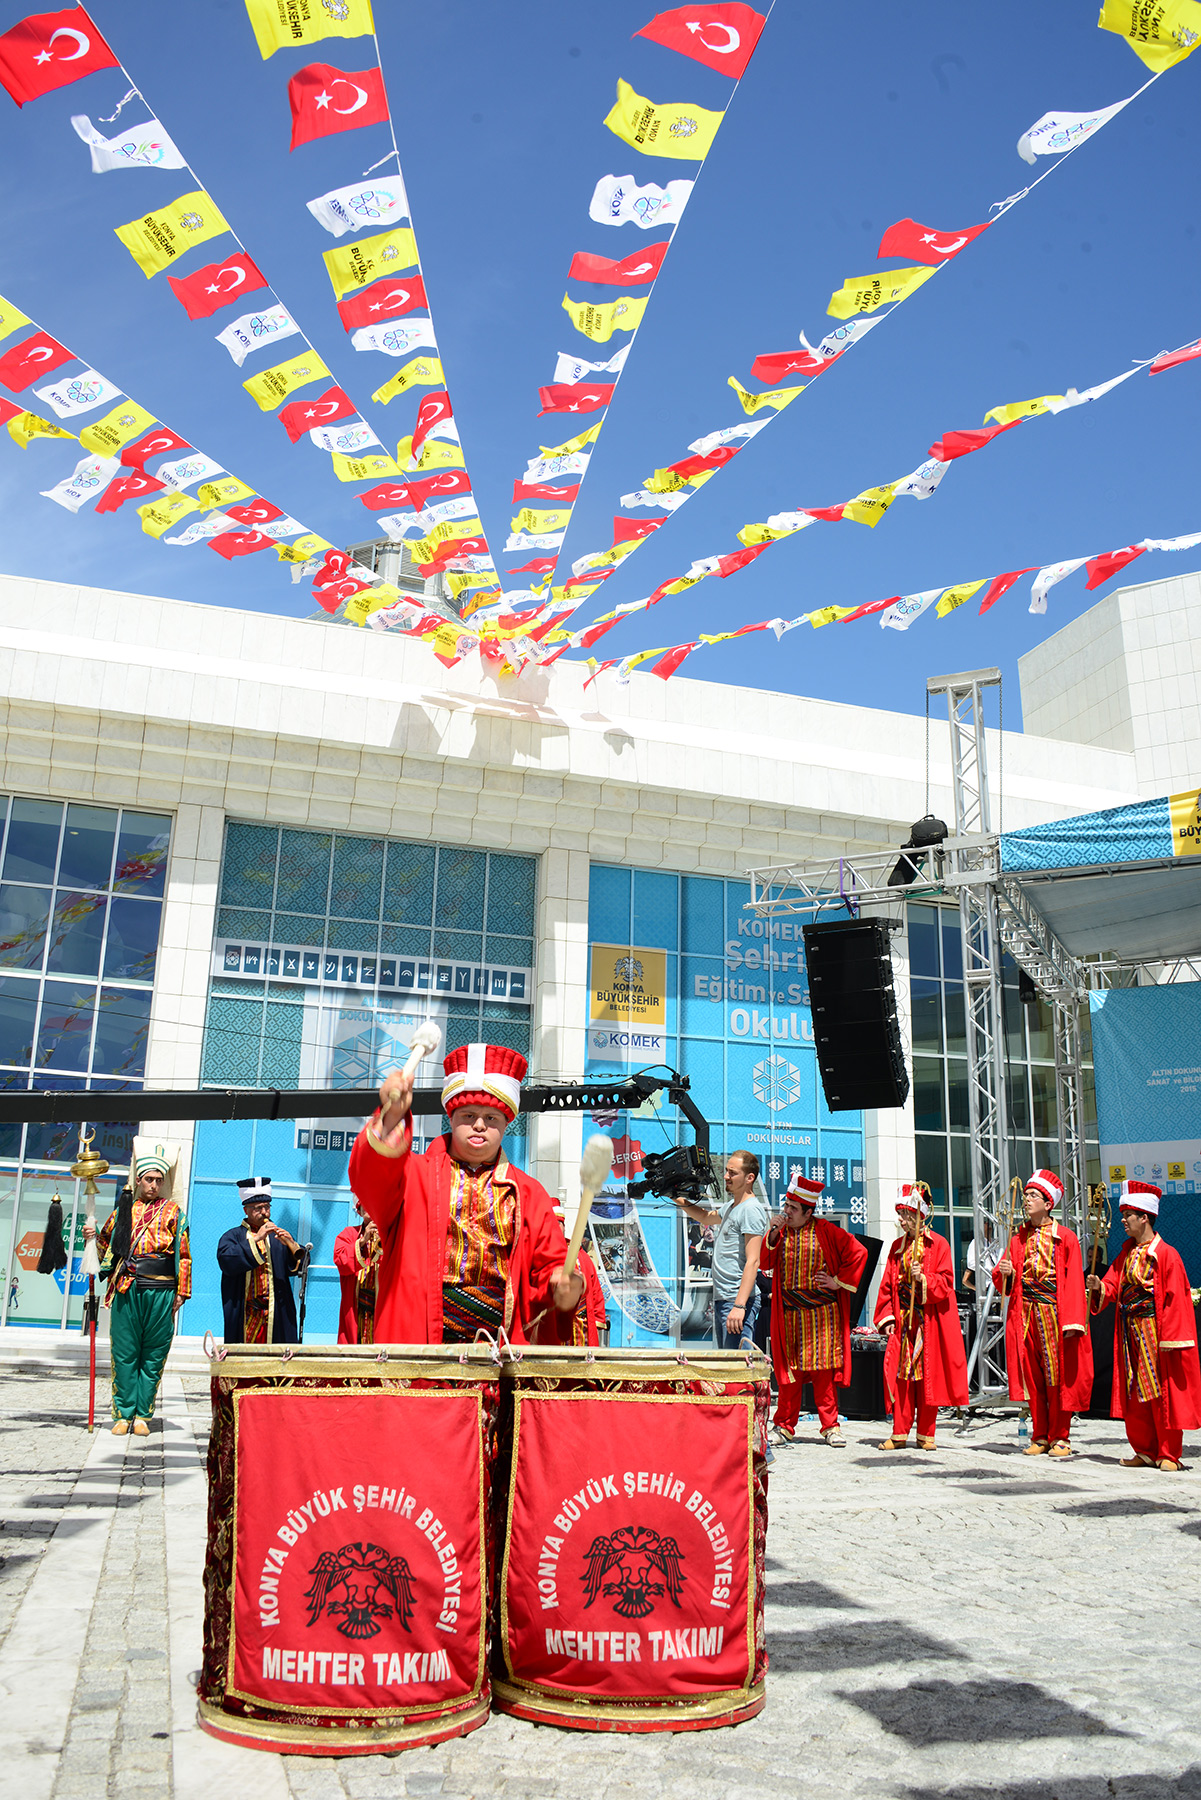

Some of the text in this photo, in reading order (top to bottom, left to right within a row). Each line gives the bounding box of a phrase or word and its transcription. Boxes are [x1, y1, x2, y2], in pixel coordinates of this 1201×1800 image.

[160, 222, 175, 241] KONYA
[738, 918, 805, 942] KOMEK
[613, 983, 644, 993] KONYA
[694, 974, 766, 1003] Eğitim
[768, 990, 785, 1003] ve
[597, 990, 660, 1006] BÜYÜKŞEHİR
[609, 1004, 647, 1013] BELEDİYESİ
[730, 1008, 815, 1041] Okulu
[609, 1033, 660, 1048] KOMEK
[1180, 1085, 1197, 1093] 2015
[765, 1121, 792, 1132] ALTIN
[747, 1133, 811, 1146] DOKUNUŞLAR
[538, 1471, 735, 1610] KONYA BÜYÜK ŞEHİR BELEDİYESİ
[258, 1484, 463, 1634] KONYA BÜYÜK ŞEHİR BELEDİYESİ
[545, 1625, 724, 1662] MEHTER TAKIMI
[262, 1646, 451, 1686] MEHTER TAKIMI
